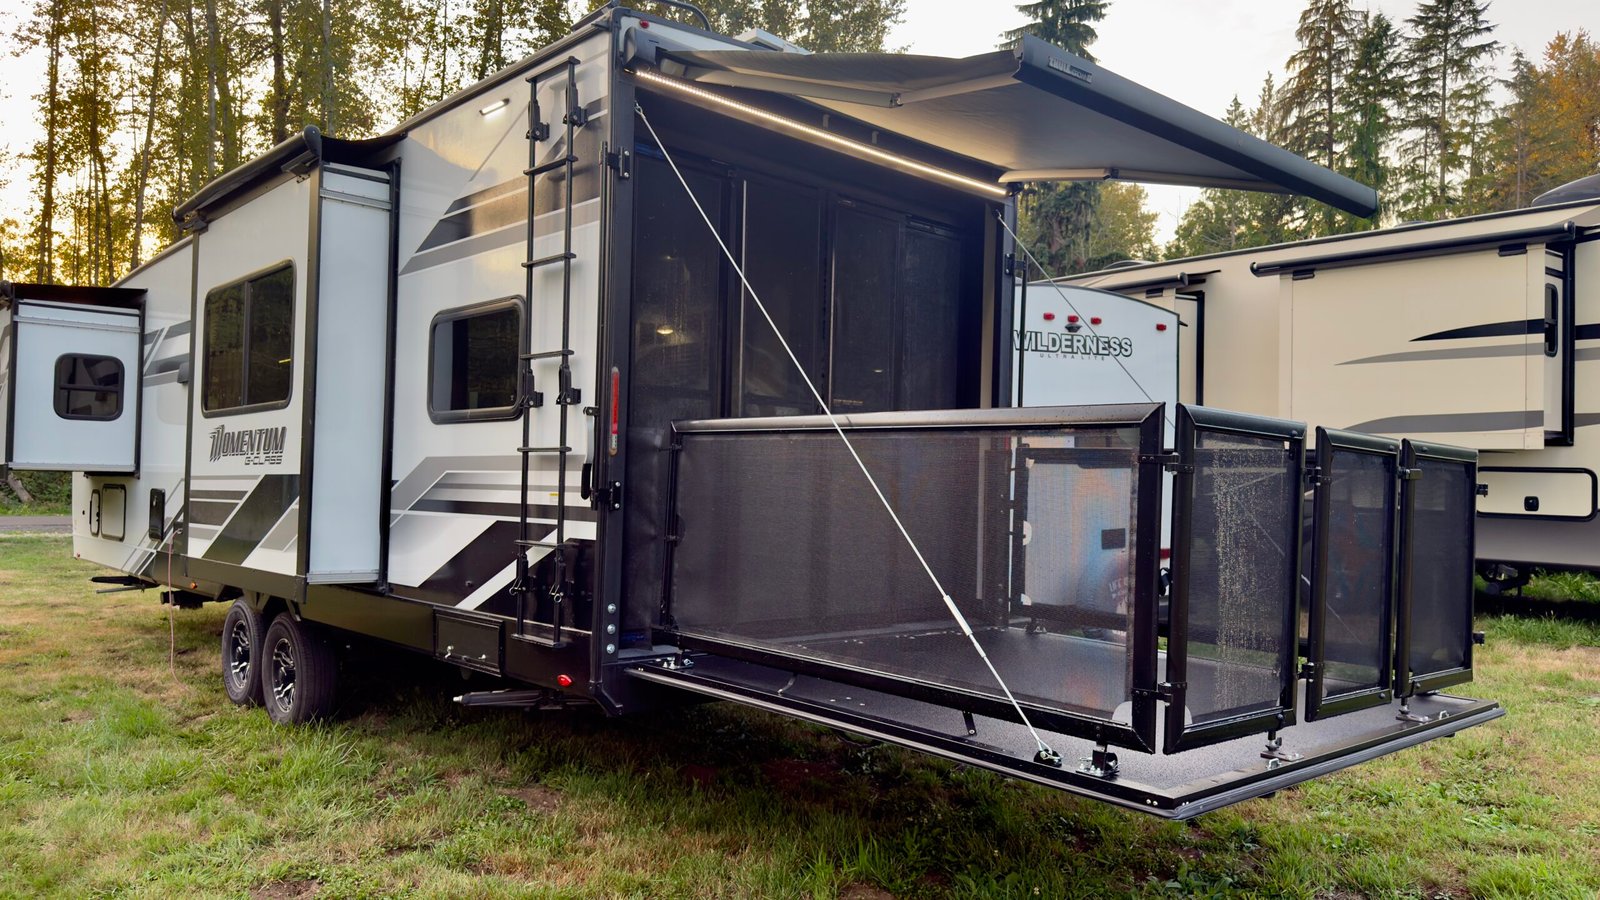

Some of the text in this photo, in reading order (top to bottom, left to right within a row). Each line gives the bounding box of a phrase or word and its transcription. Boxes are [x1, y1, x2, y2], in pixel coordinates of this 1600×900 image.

[1013, 329, 1133, 358] WILDERNESS
[209, 424, 287, 463] MOMENTUM
[244, 455, 283, 466] G-CLASS
